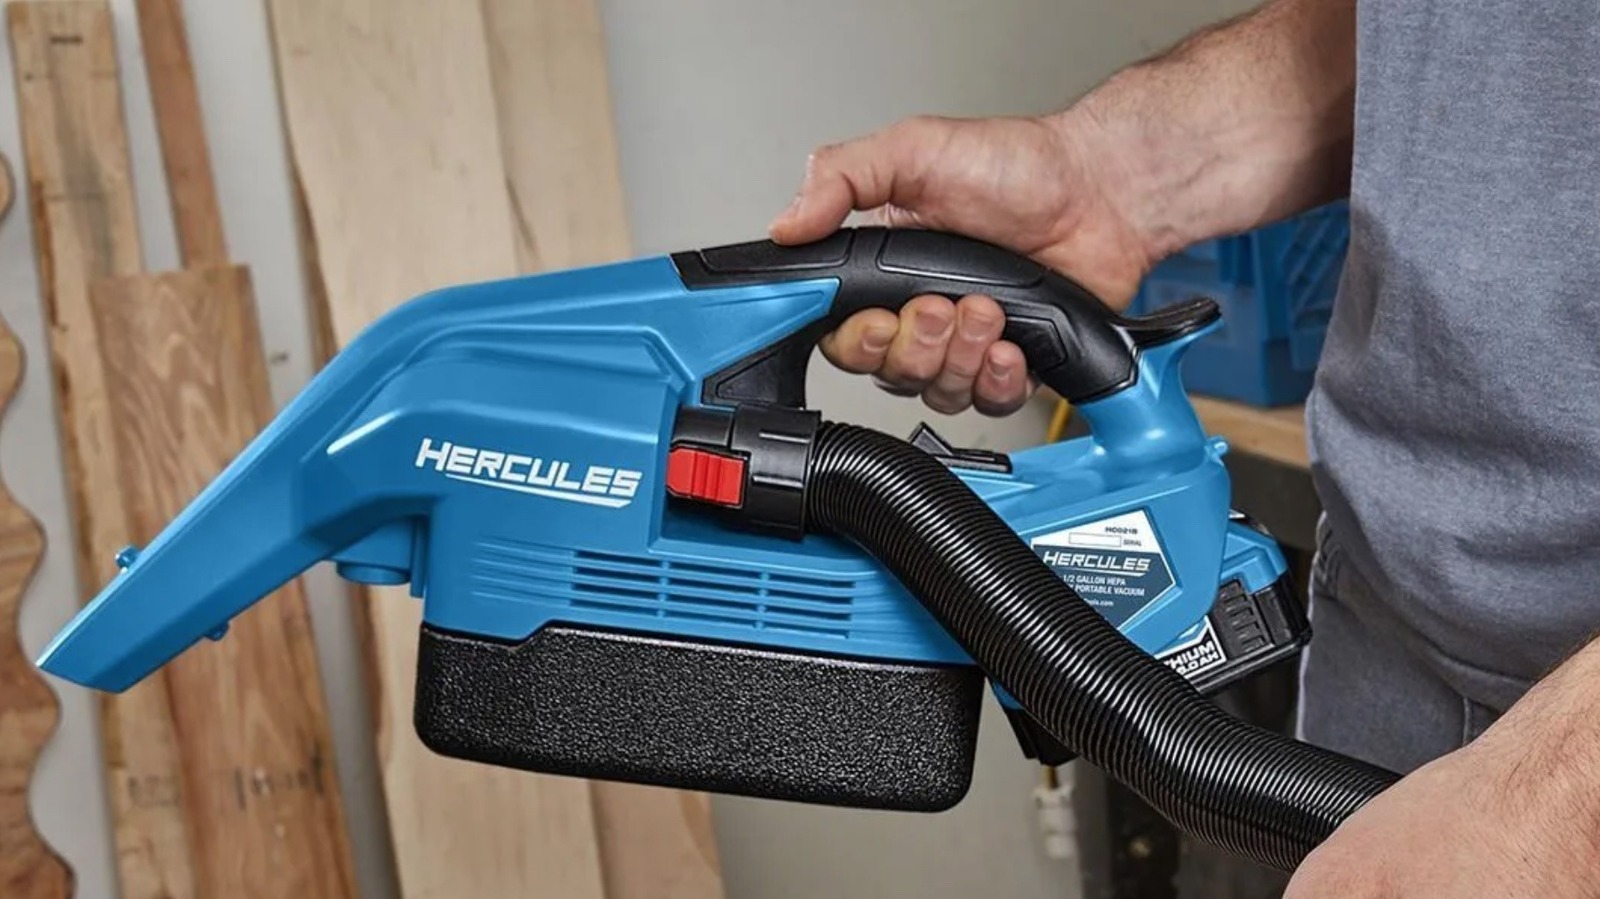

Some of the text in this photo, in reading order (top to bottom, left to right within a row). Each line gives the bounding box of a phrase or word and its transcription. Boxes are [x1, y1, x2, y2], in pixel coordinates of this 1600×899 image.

[415, 437, 643, 497] HERCULES
[1042, 551, 1151, 572] HERCULES
[1063, 574, 1126, 586] 1/2 GALLON HEPA
[1074, 584, 1112, 594] PORTABLE
[1114, 587, 1145, 596] VACUUM
